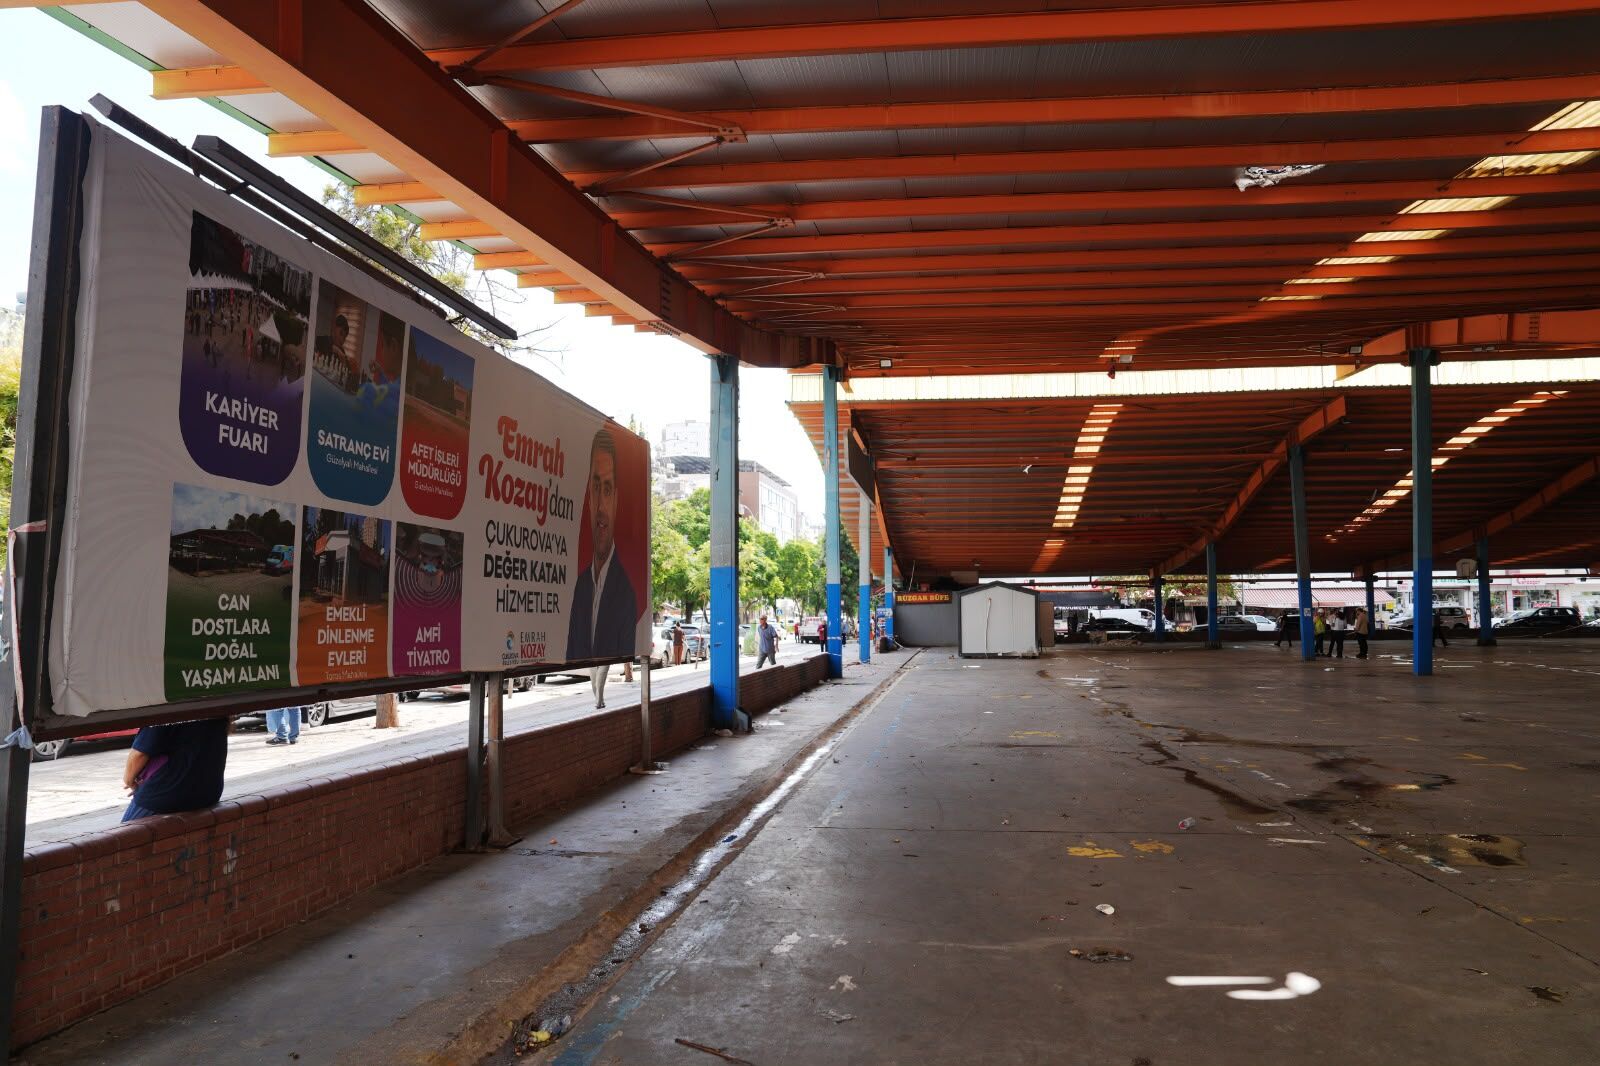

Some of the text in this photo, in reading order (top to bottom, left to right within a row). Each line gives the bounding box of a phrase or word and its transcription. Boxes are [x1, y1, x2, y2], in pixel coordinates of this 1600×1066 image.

[205, 391, 279, 431] KARİYER
[218, 424, 268, 455] FUARI
[317, 429, 390, 464] SATRANÇ EVİ
[497, 415, 564, 479] Emrah
[411, 442, 459, 468] AFET İŞLERİ
[408, 459, 461, 487] MÜDÜRLÜĞÜ
[478, 453, 574, 527] Kozay'dan
[485, 519, 568, 557] ÇUKUROVA'YA
[483, 550, 567, 585] DEĞER KATAN
[218, 593, 250, 611] CAN
[496, 584, 560, 614] HİZMETLER
[930, 593, 950, 601] BÜFE
[326, 603, 366, 622] EMEKLİ
[191, 618, 271, 636] DOSTLARA
[317, 624, 375, 645] DİNLENME
[415, 622, 441, 643] AMFİ
[520, 631, 546, 643] EMRAH
[204, 639, 257, 661] DOĞAL
[327, 646, 367, 667] EVLERİ
[406, 646, 450, 668] TİYATRO
[520, 643, 546, 659] KOZAY
[181, 664, 280, 689] YAŞAM ALANI
